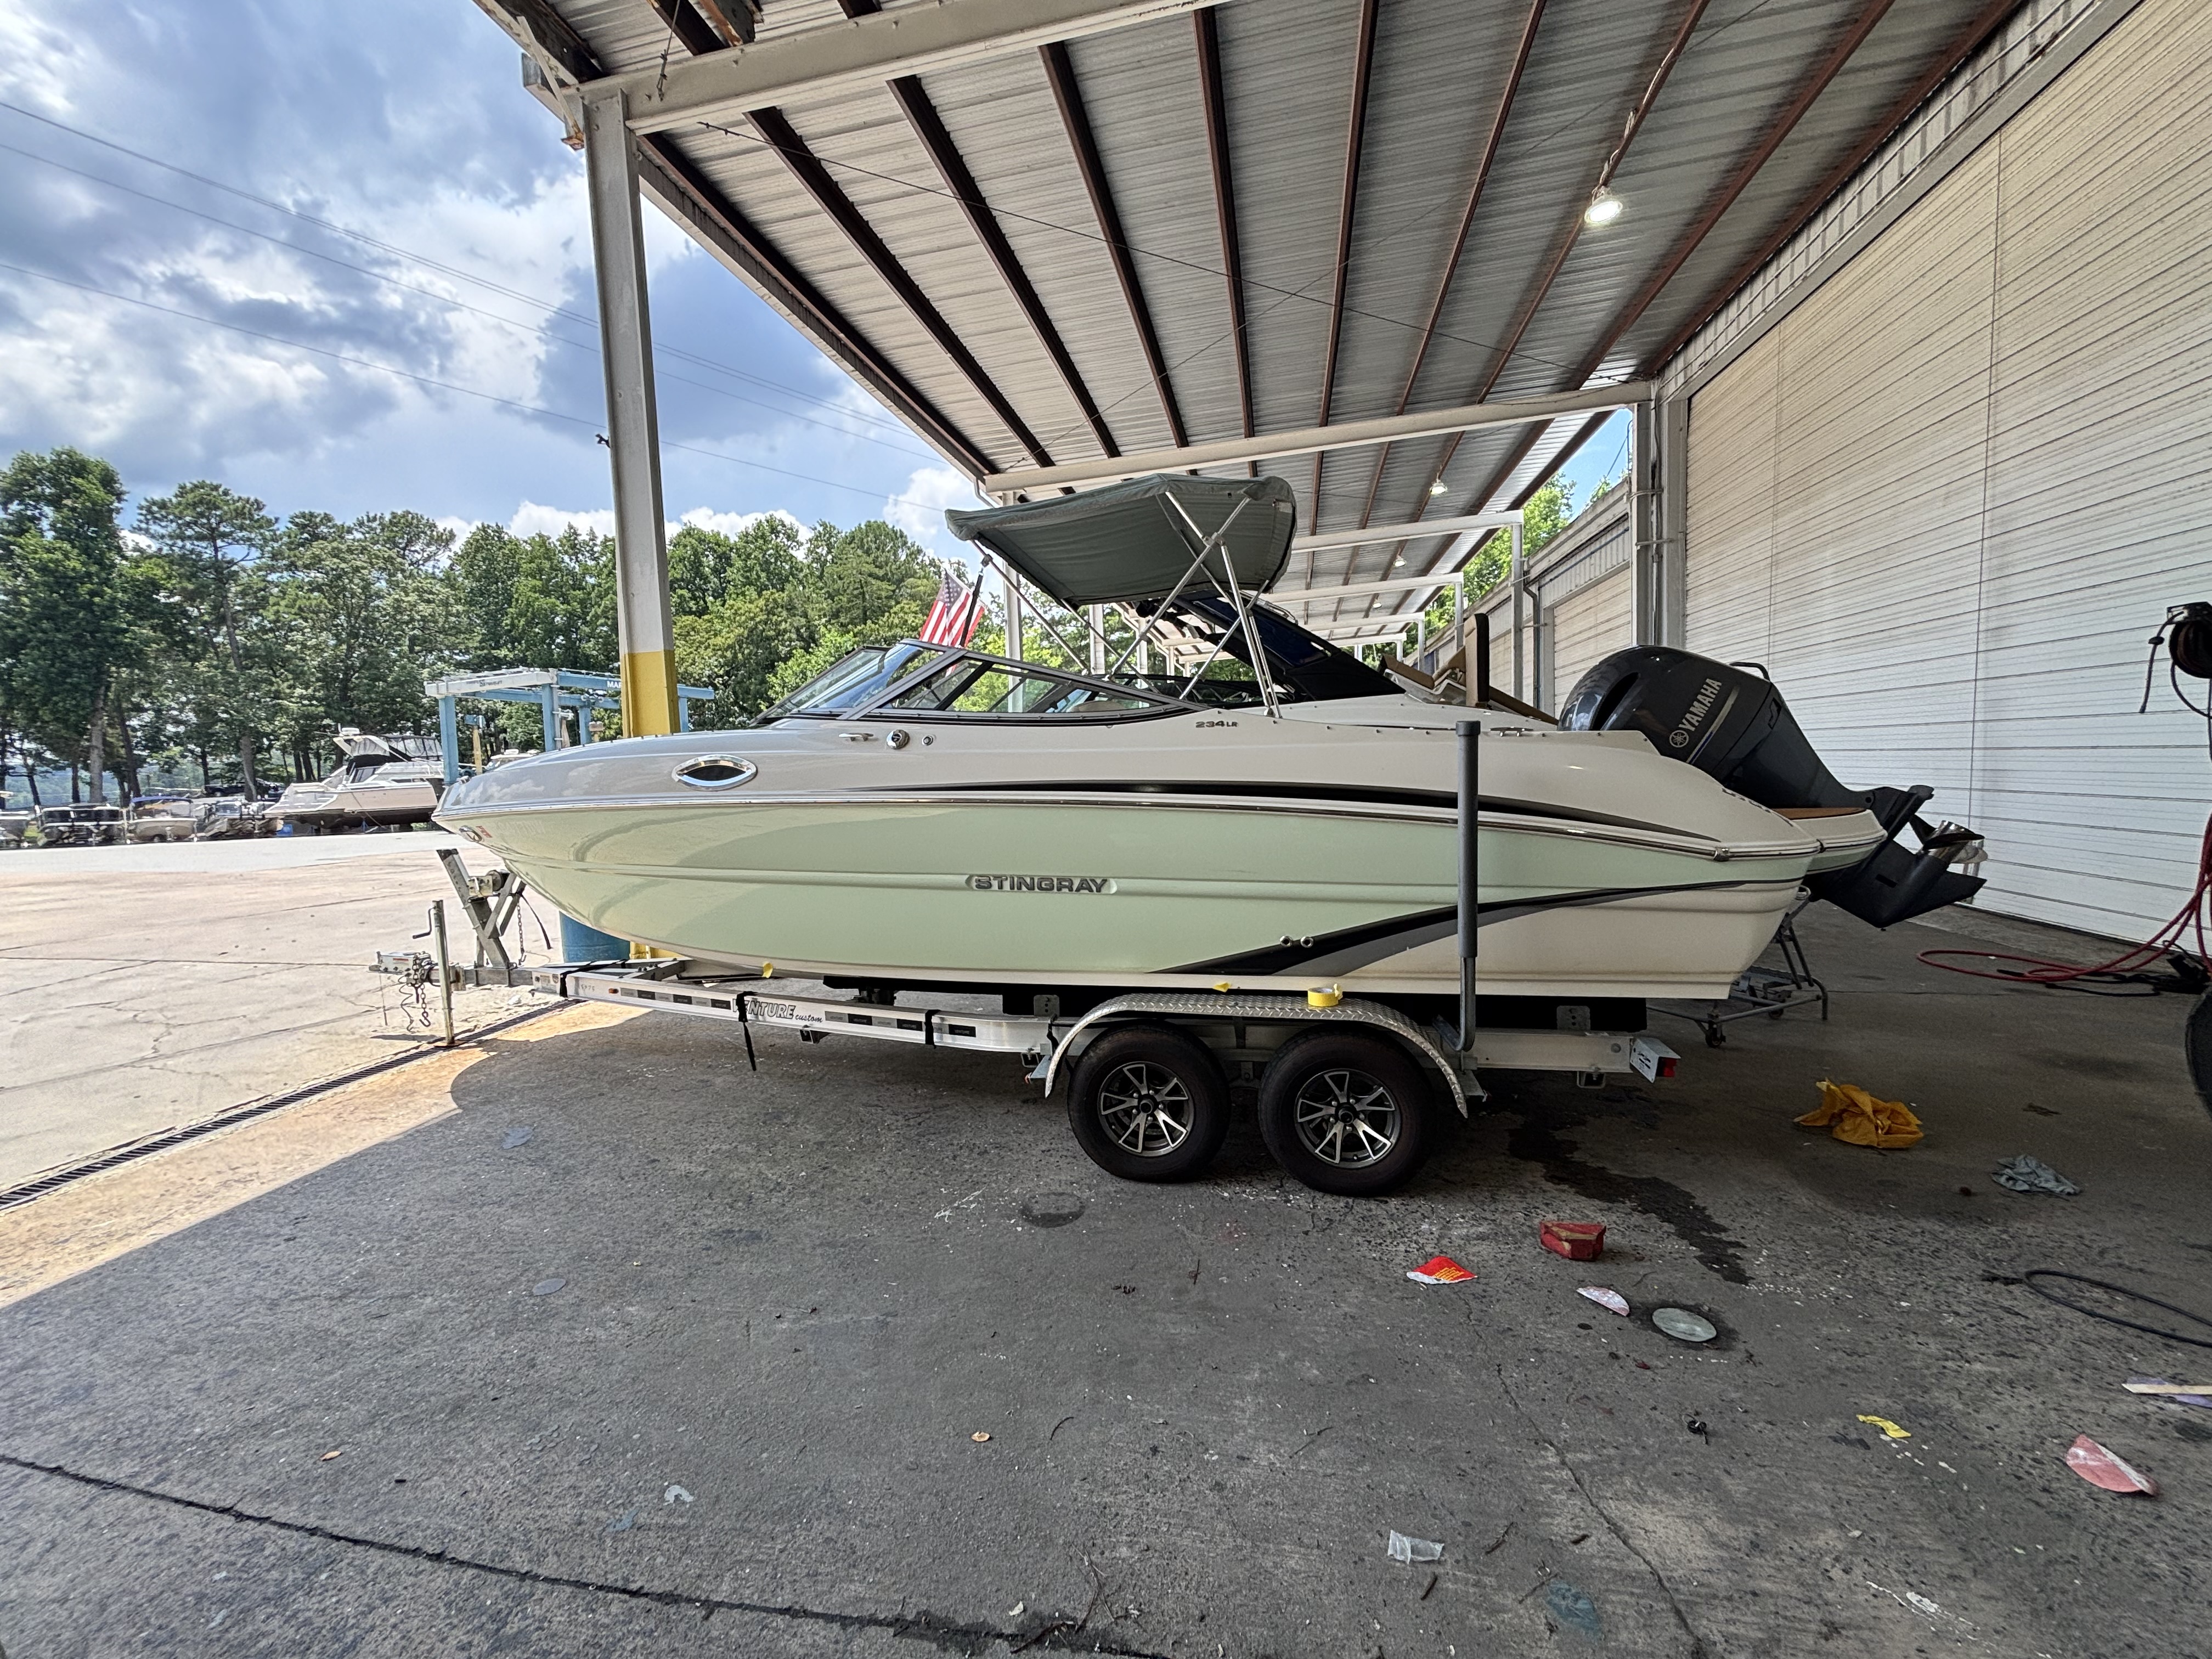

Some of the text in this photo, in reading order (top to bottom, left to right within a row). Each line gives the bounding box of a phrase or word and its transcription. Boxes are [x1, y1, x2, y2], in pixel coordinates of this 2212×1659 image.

[1678, 678, 1722, 731] YAMAHA
[974, 876, 1108, 893] STINGRAY
[795, 1014, 823, 1023] custom
